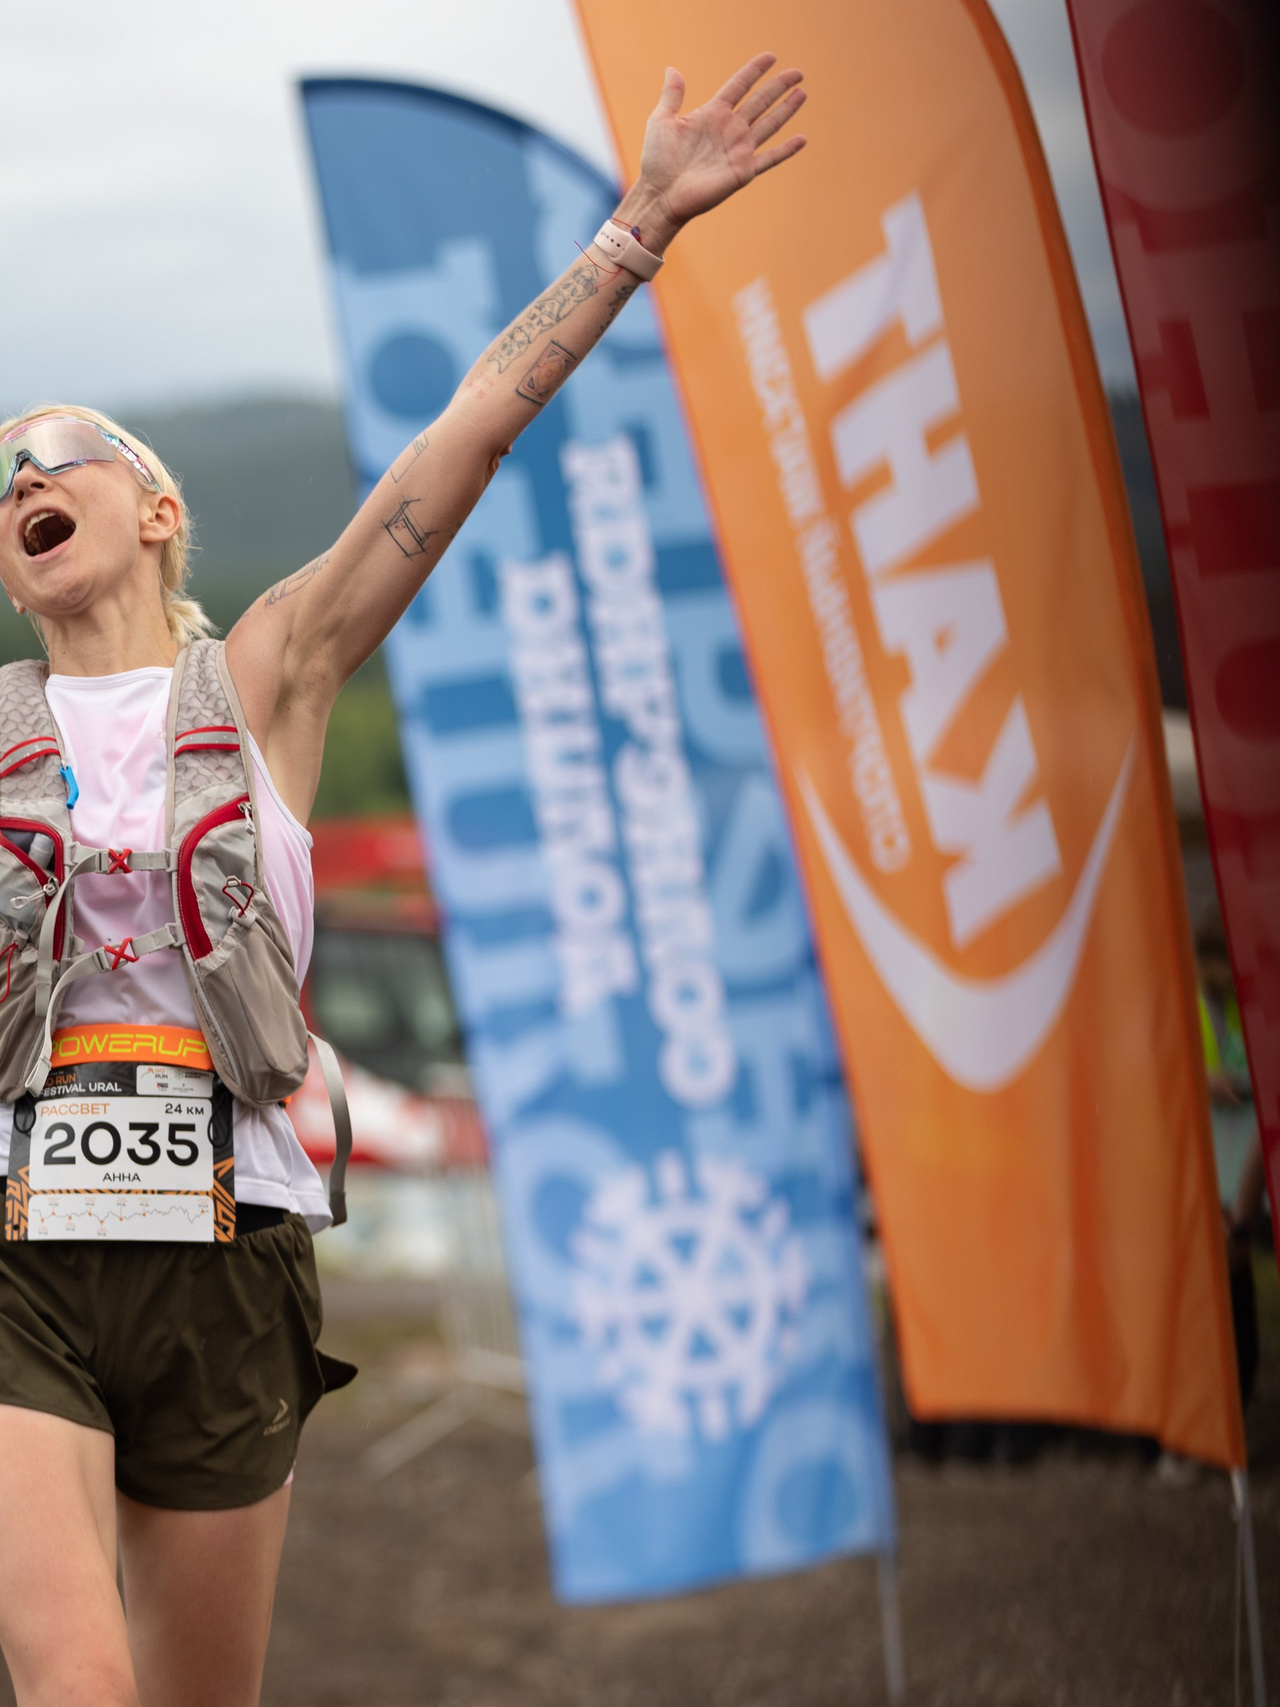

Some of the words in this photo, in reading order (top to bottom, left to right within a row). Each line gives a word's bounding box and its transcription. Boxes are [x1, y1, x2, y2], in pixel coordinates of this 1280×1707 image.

[52, 1033, 207, 1058] OWERUP
[55, 1073, 76, 1086] RUN
[40, 1083, 86, 1097] ESTIVAL
[88, 1082, 122, 1092] URAL
[40, 1103, 110, 1117] РАССВЕТ
[165, 1103, 183, 1114] 24
[43, 1121, 199, 1167] 2035
[102, 1172, 141, 1183] АННА
